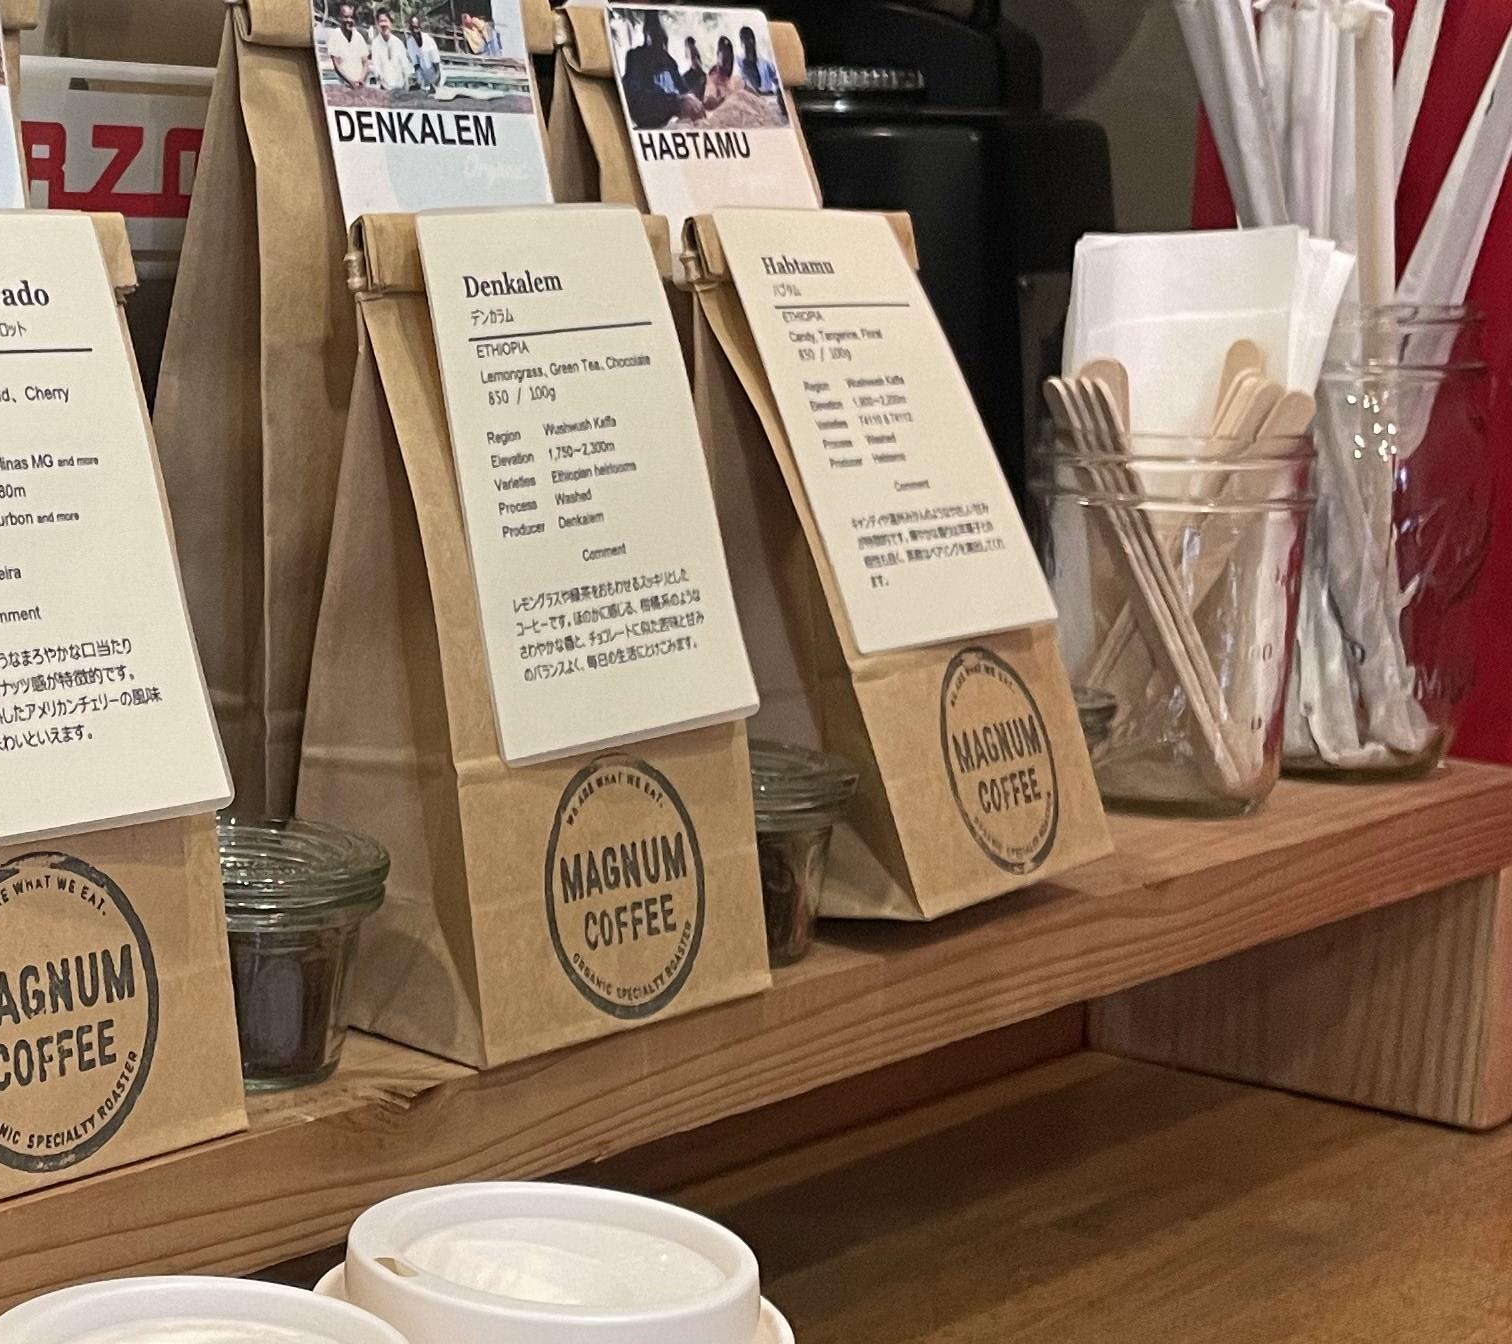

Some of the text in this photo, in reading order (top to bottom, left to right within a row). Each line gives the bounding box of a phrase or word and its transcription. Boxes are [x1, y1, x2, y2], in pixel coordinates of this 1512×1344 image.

[333, 110, 498, 147] DENKALEM
[639, 131, 752, 162] HABTAMU
[761, 254, 836, 275] Habtamu
[462, 269, 564, 299] Denkalem
[476, 343, 530, 359] ETHIOPIA
[549, 361, 580, 377] Green
[24, 386, 70, 404] Cherry
[486, 430, 521, 446] Region
[31, 454, 54, 469] MG
[952, 714, 1042, 774] MAGNUM
[977, 767, 1041, 814] COFFEE
[560, 831, 688, 904] MAGNUM
[56, 875, 76, 894] WE
[584, 893, 677, 951] COFFEE
[26, 1116, 96, 1149] SPECIALTY
[96, 1049, 139, 1121] ROASTER
